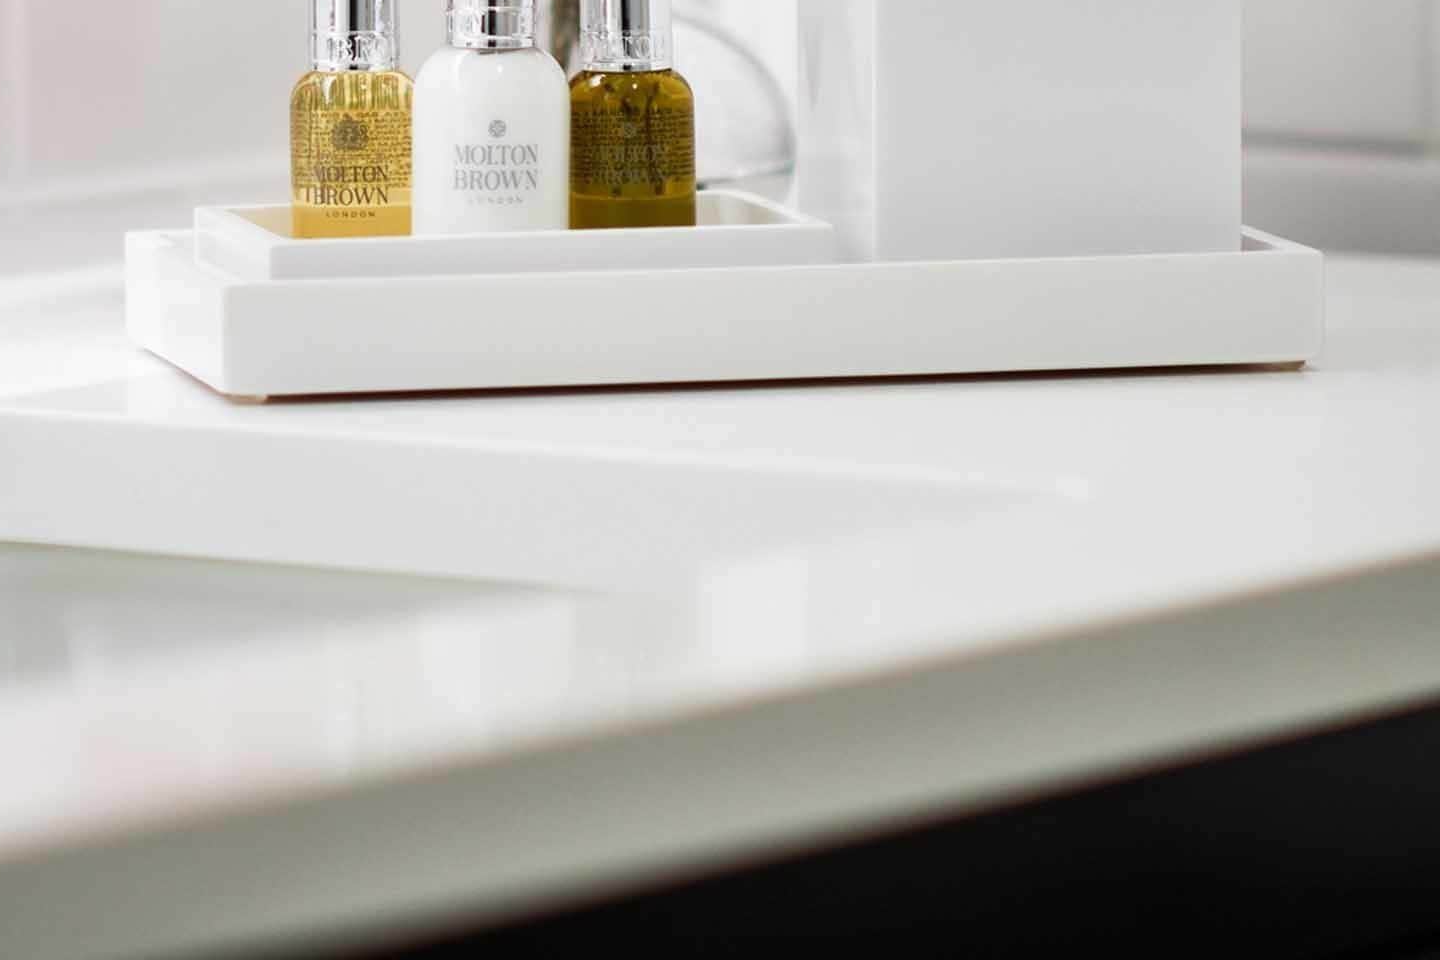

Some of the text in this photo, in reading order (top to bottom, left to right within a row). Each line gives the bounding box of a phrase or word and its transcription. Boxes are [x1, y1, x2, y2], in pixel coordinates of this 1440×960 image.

[453, 144, 538, 165] MOLTON
[313, 166, 389, 183] MOLTON
[453, 169, 538, 191] BROWN
[326, 210, 376, 219] LONDON
